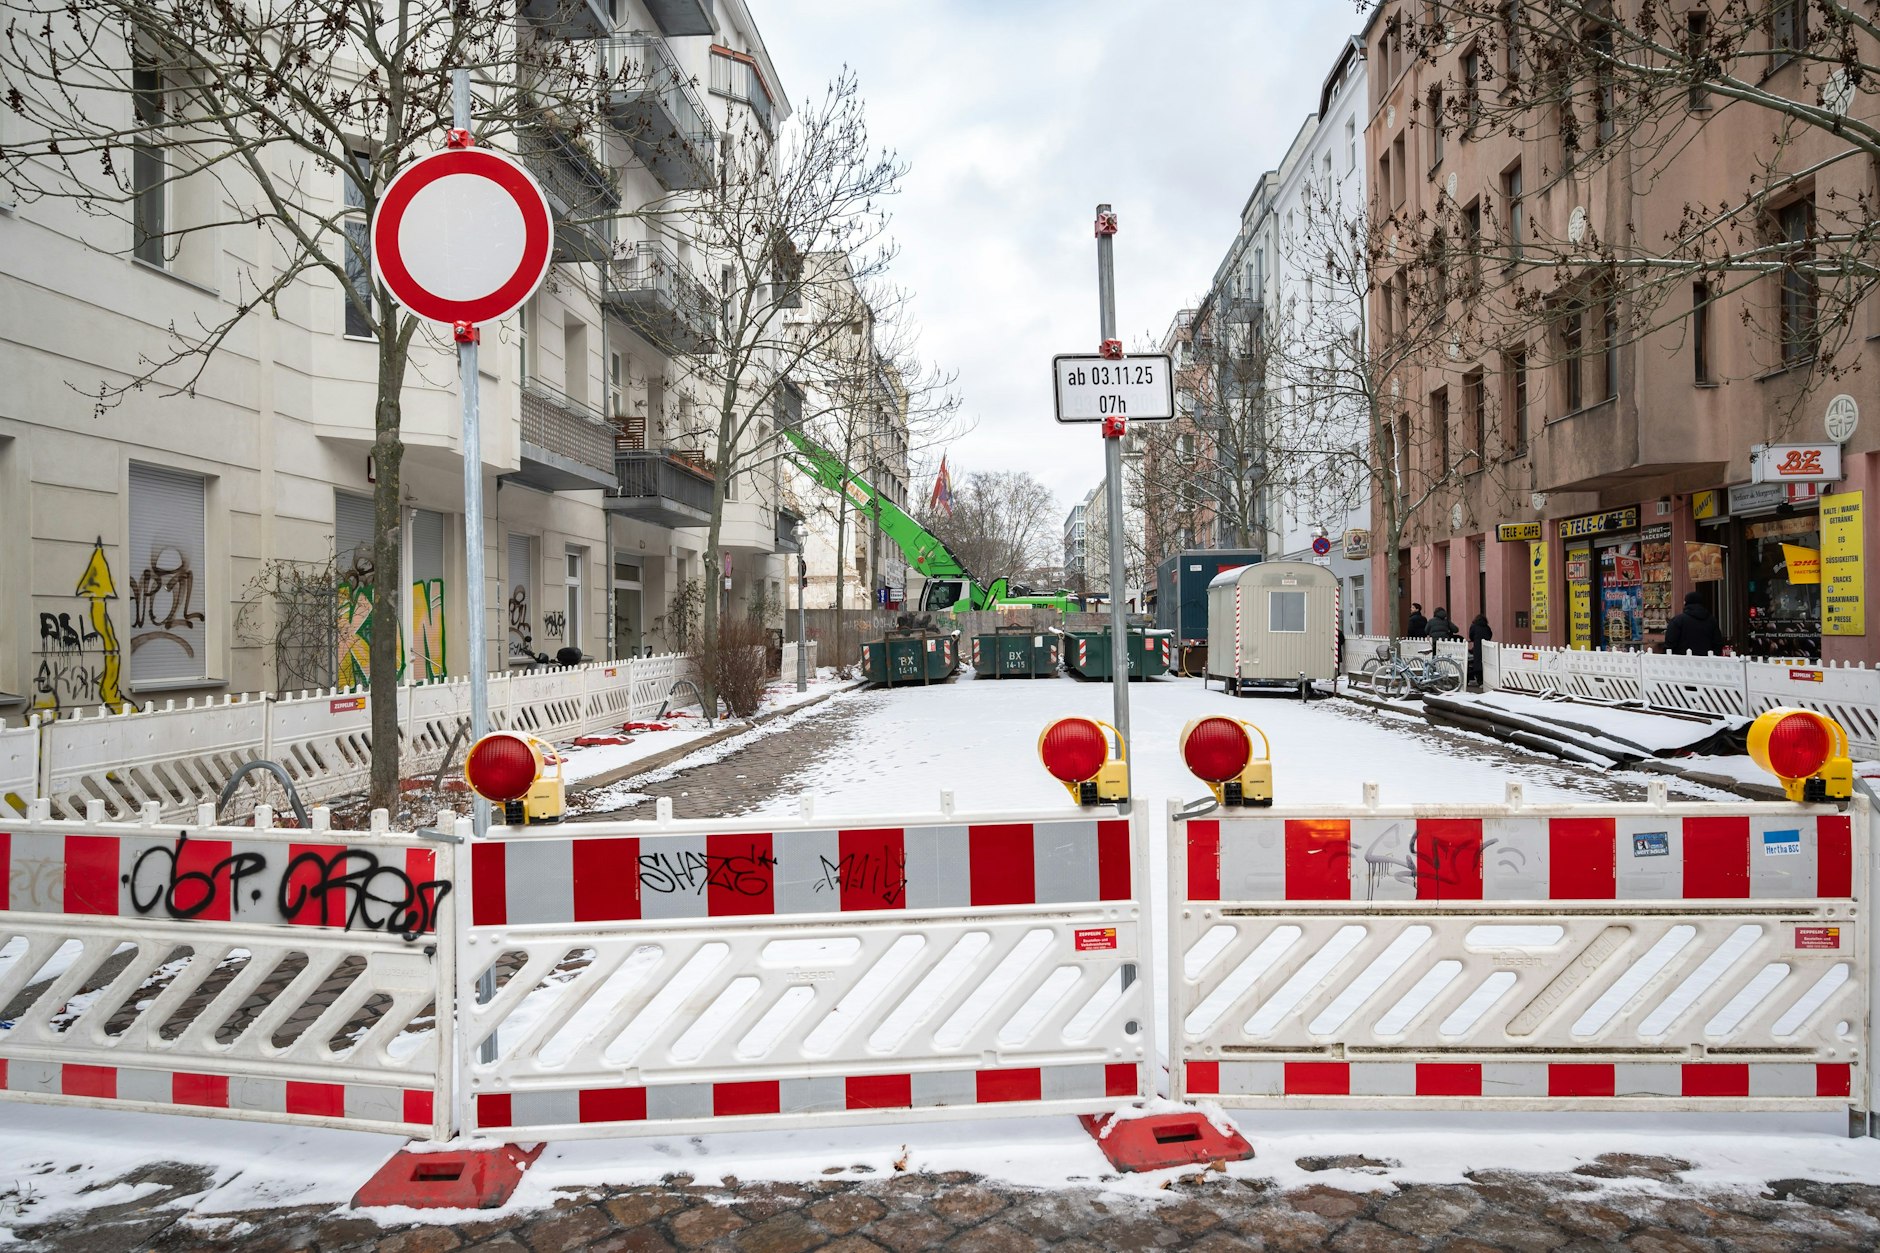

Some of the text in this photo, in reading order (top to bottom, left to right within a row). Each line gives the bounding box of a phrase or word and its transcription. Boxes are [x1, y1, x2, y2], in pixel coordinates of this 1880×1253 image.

[1068, 366, 1153, 386] ab 03.11.25
[1100, 395, 1126, 414] 07h
[1694, 492, 1713, 517] UMUT
[1502, 527, 1517, 539] TELE
[1523, 525, 1539, 537] CAFE
[1648, 526, 1664, 534] UMUT
[1837, 536, 1846, 544] EIS
[1825, 555, 1859, 565] SÜSSIGKEITEN
[1833, 575, 1852, 584] SNACKS
[1826, 595, 1859, 604] TABAKWAREN
[900, 655, 914, 666] BX
[1008, 651, 1023, 661] BX
[1006, 661, 1025, 669] 14-15
[1766, 844, 1800, 855] Hertha BSC
